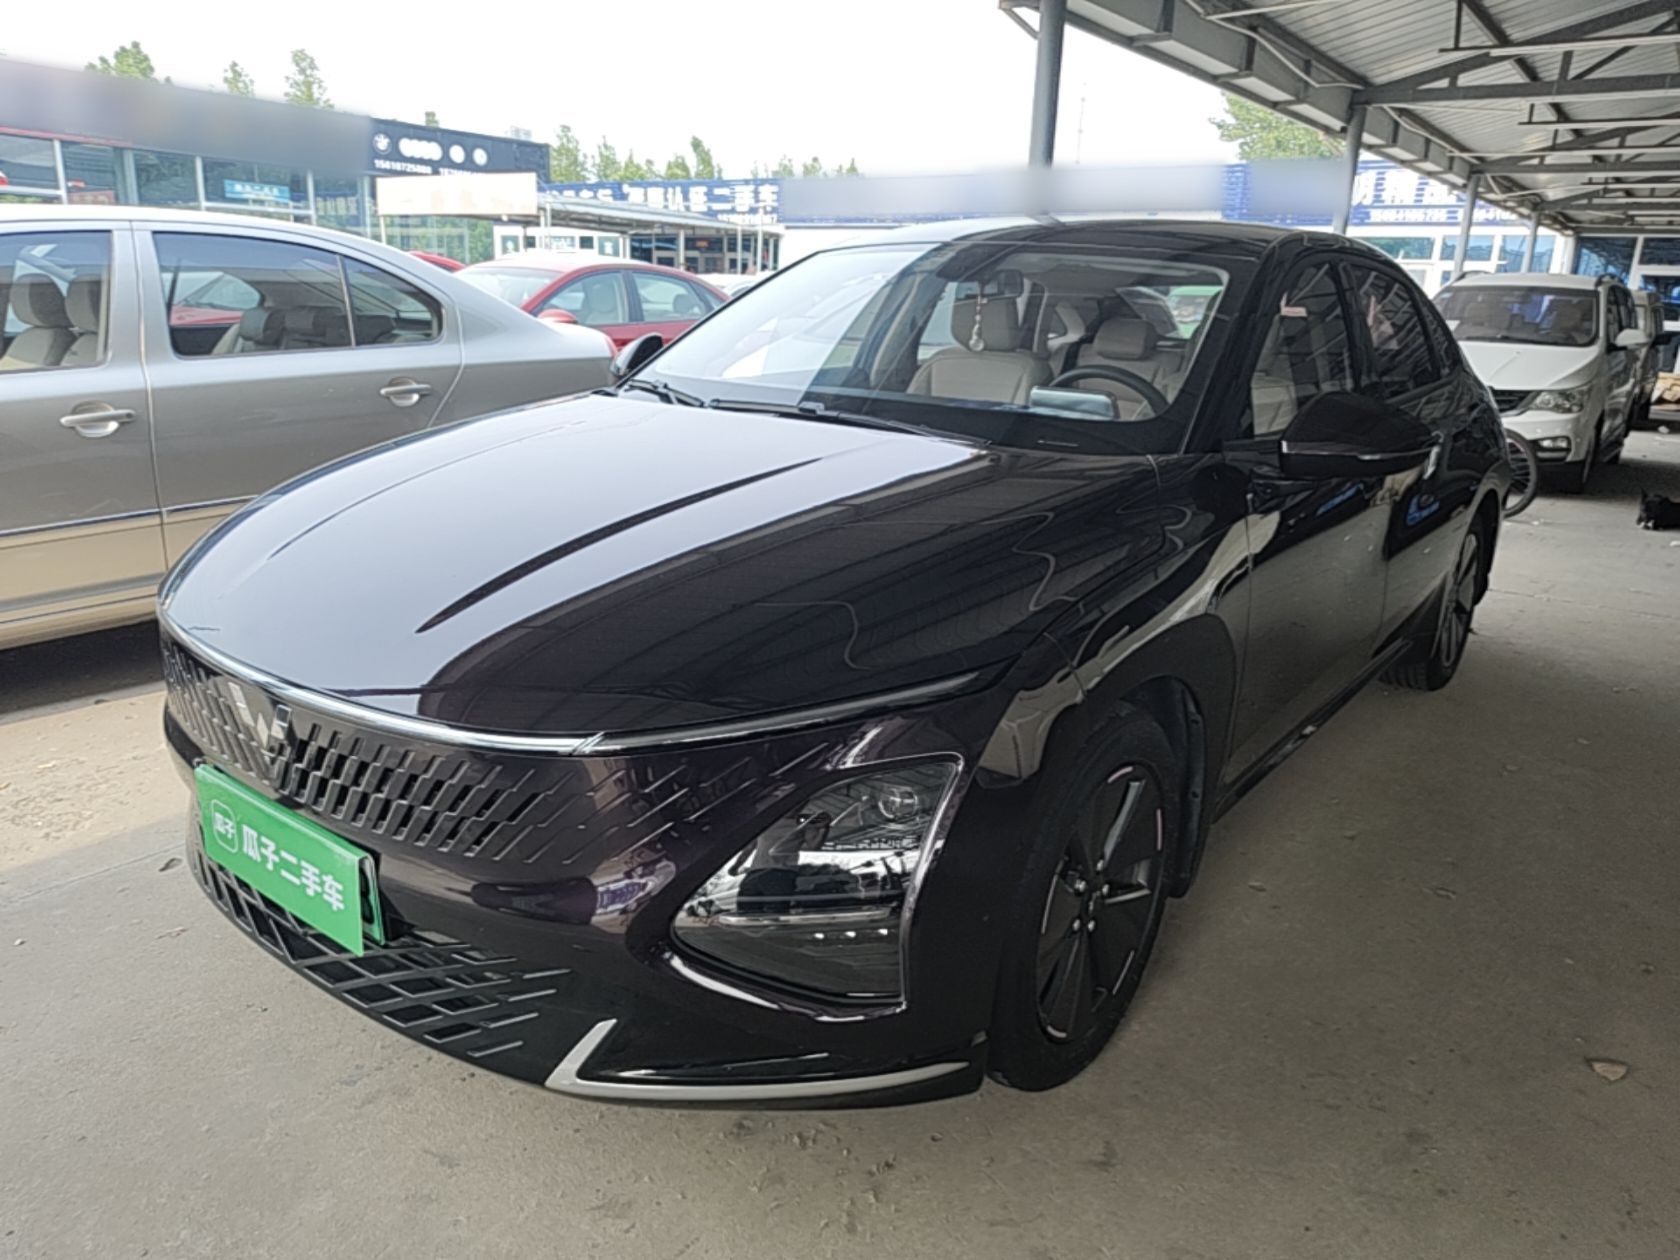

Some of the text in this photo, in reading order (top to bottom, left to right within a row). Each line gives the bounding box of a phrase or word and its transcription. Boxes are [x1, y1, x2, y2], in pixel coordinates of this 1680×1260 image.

[242, 823, 345, 911] 瓜子二手车
